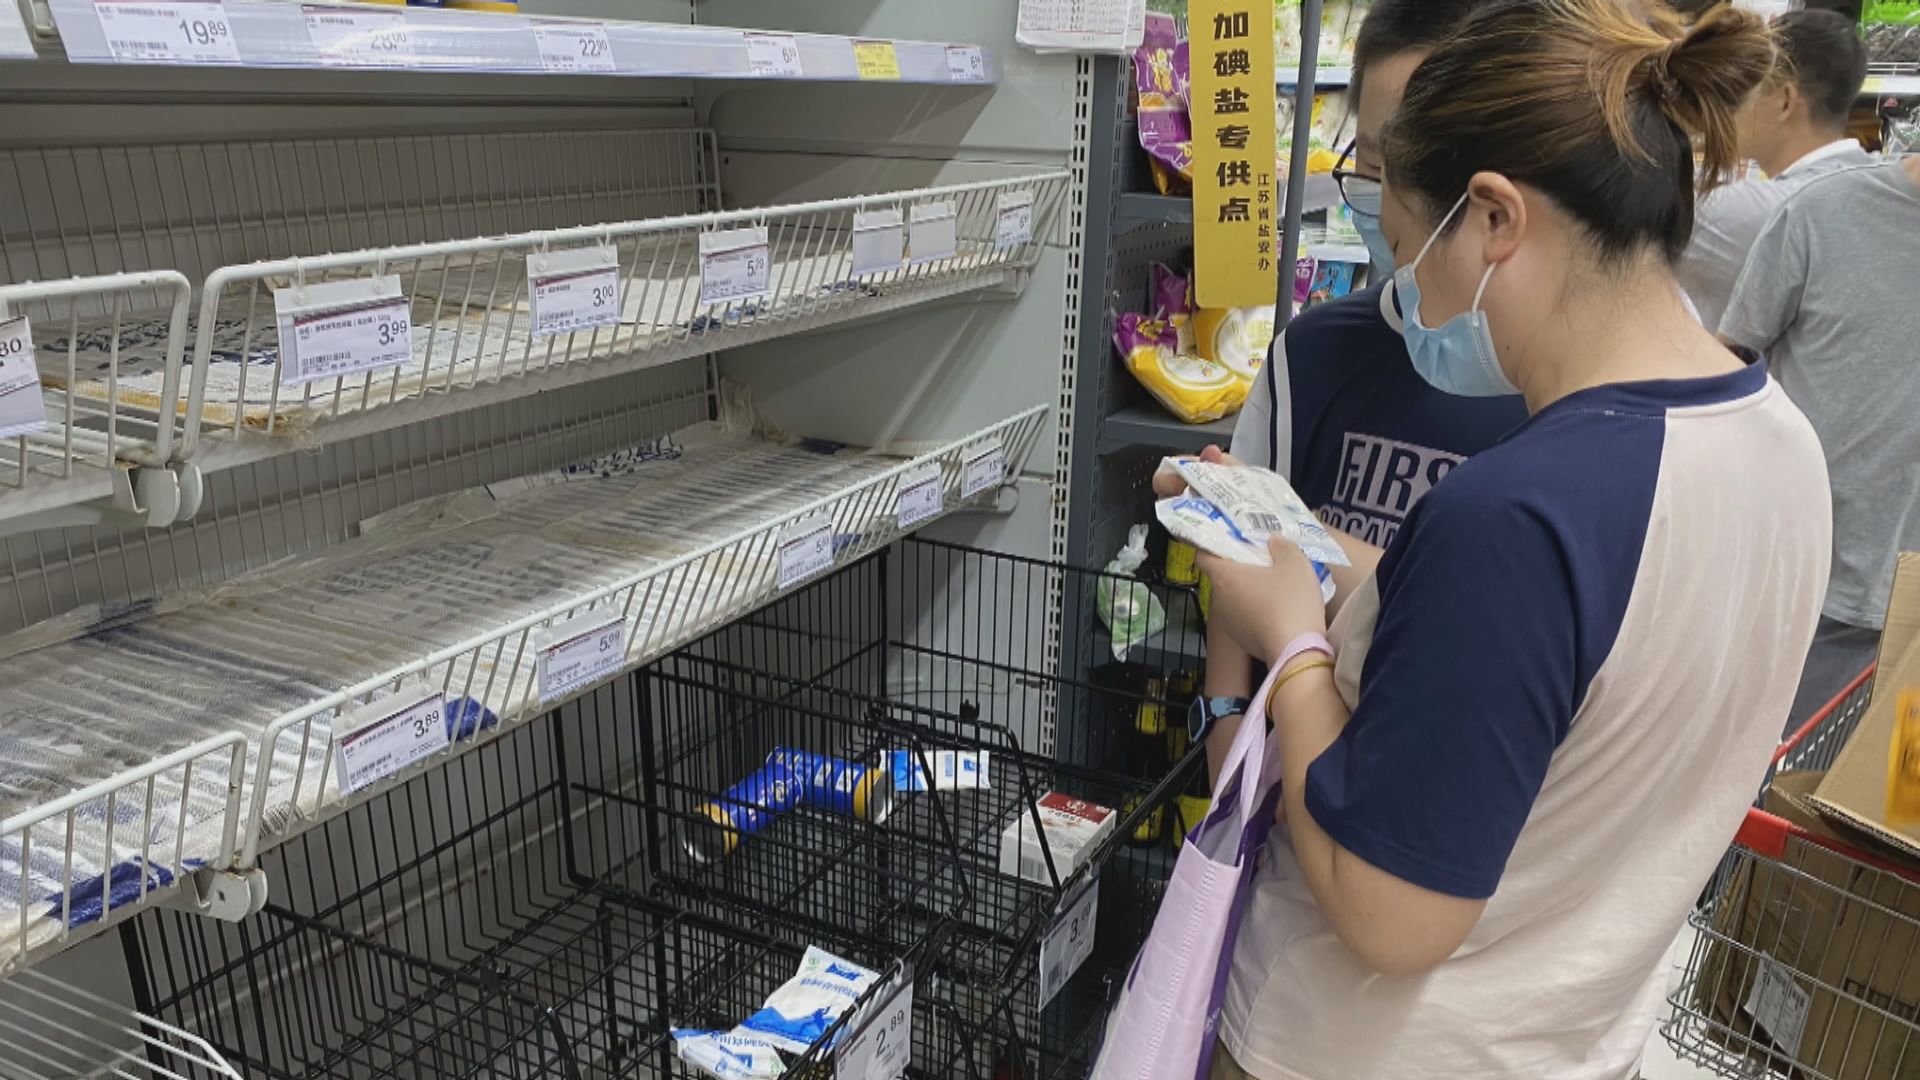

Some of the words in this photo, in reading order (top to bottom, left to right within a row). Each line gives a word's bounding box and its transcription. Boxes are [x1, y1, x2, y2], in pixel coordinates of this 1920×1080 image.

[179, 19, 227, 45] 19.89
[1212, 12, 1251, 223] 加碘盐专供点
[593, 284, 614, 307] 3.00
[378, 319, 408, 346] 3.99
[413, 710, 440, 739] 3.89
[876, 1009, 905, 1058] 2.89
